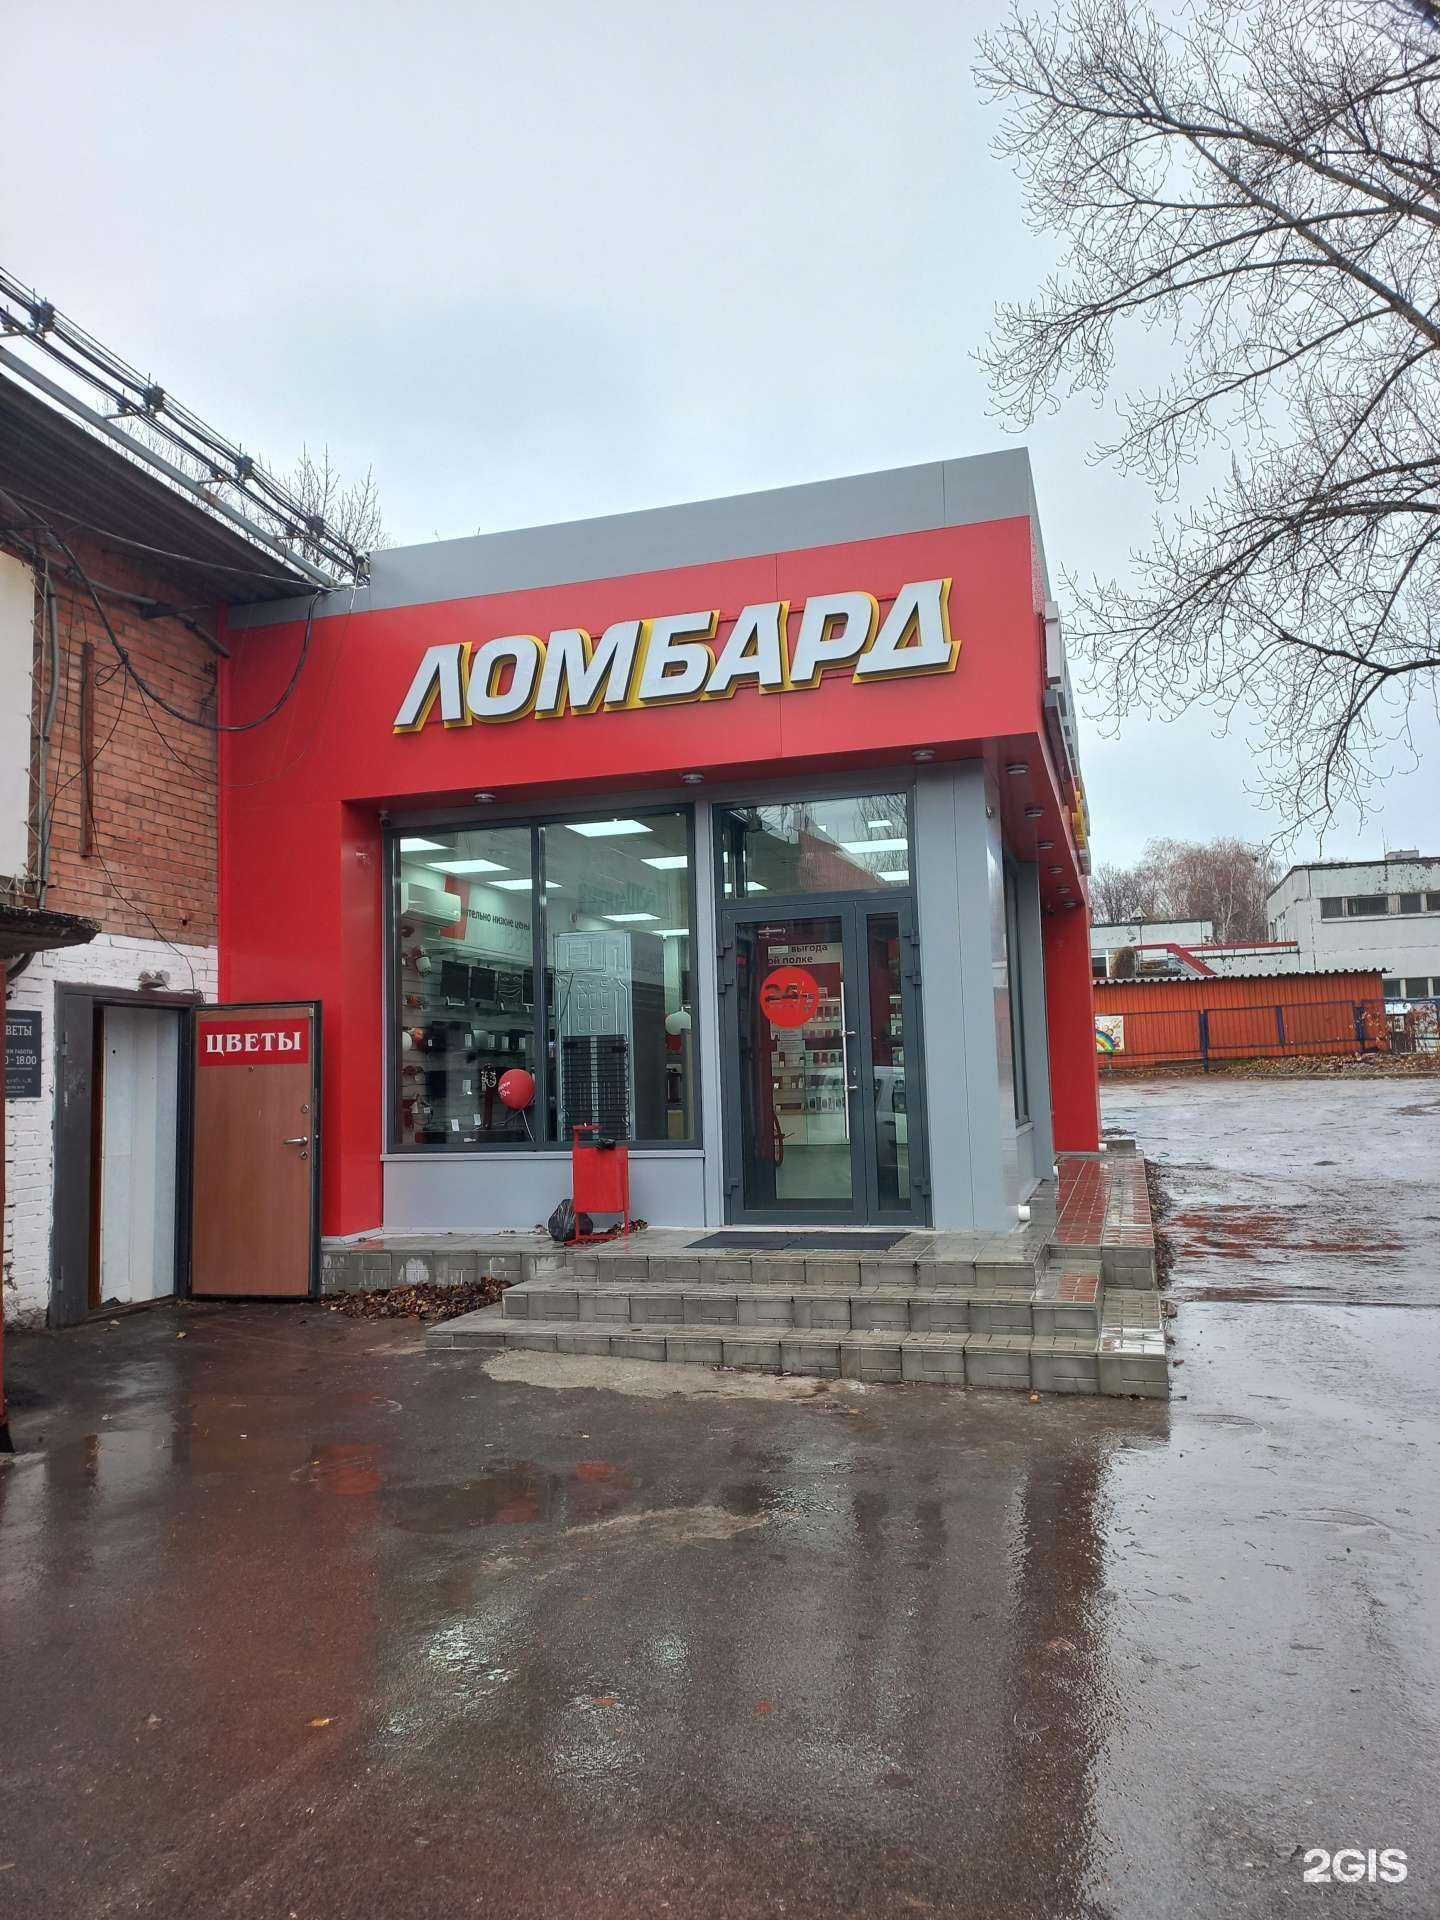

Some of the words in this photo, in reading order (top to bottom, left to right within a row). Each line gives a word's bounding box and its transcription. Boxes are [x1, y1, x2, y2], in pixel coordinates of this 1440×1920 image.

[392, 577, 962, 735] ЛОМБАРД
[791, 944, 828, 954] выгода
[783, 955, 814, 965] полке
[5, 1025, 33, 1036] ВЕТЫ
[206, 1031, 302, 1057] ЦВЕТЫ
